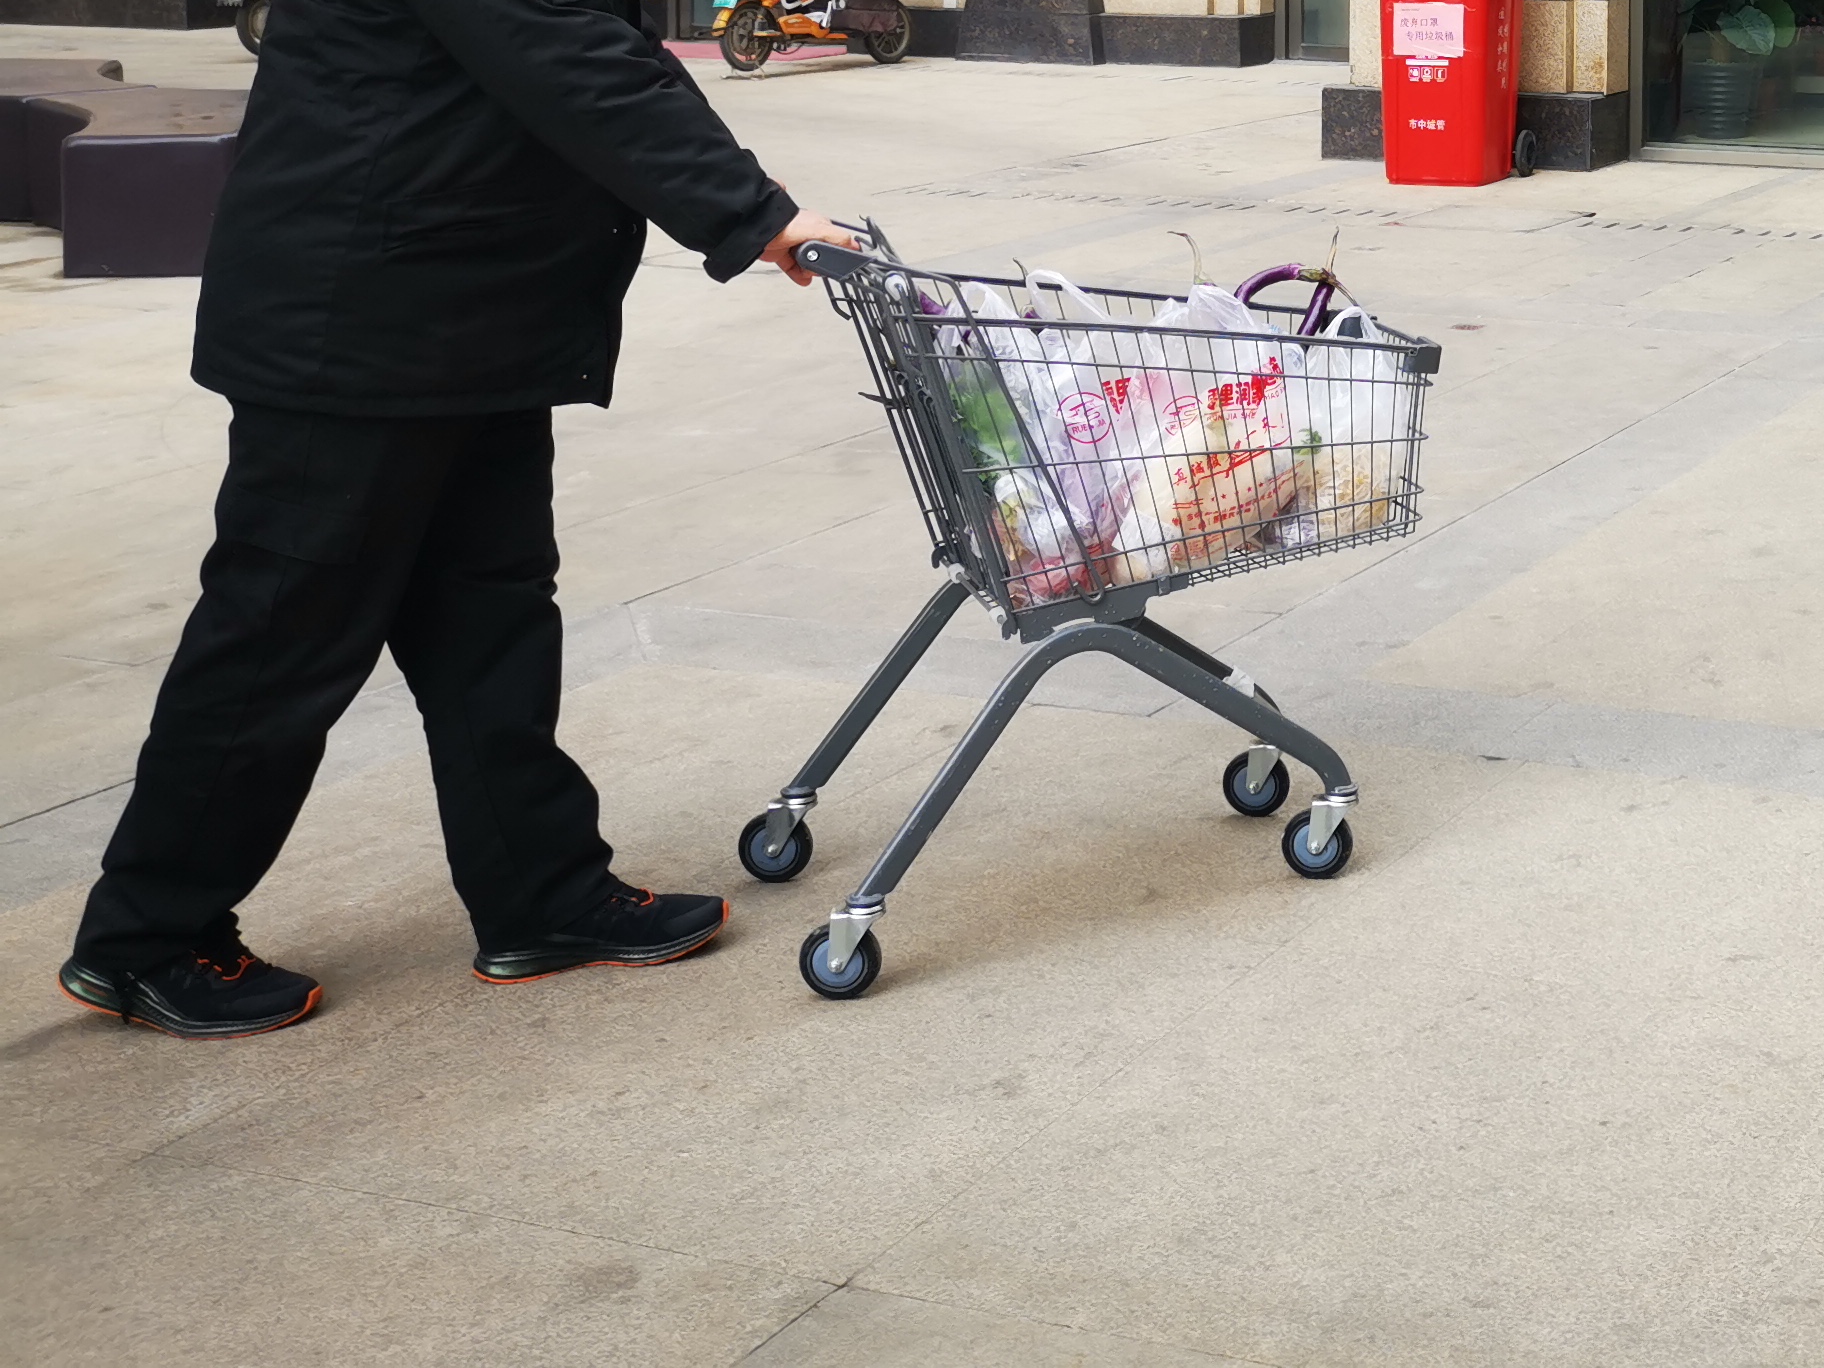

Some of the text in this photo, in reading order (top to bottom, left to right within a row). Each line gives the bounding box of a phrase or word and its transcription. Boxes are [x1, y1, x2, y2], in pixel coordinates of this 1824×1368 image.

[1406, 31, 1455, 42] 专用垃圾桶
[1408, 118, 1446, 131] 市中城管
